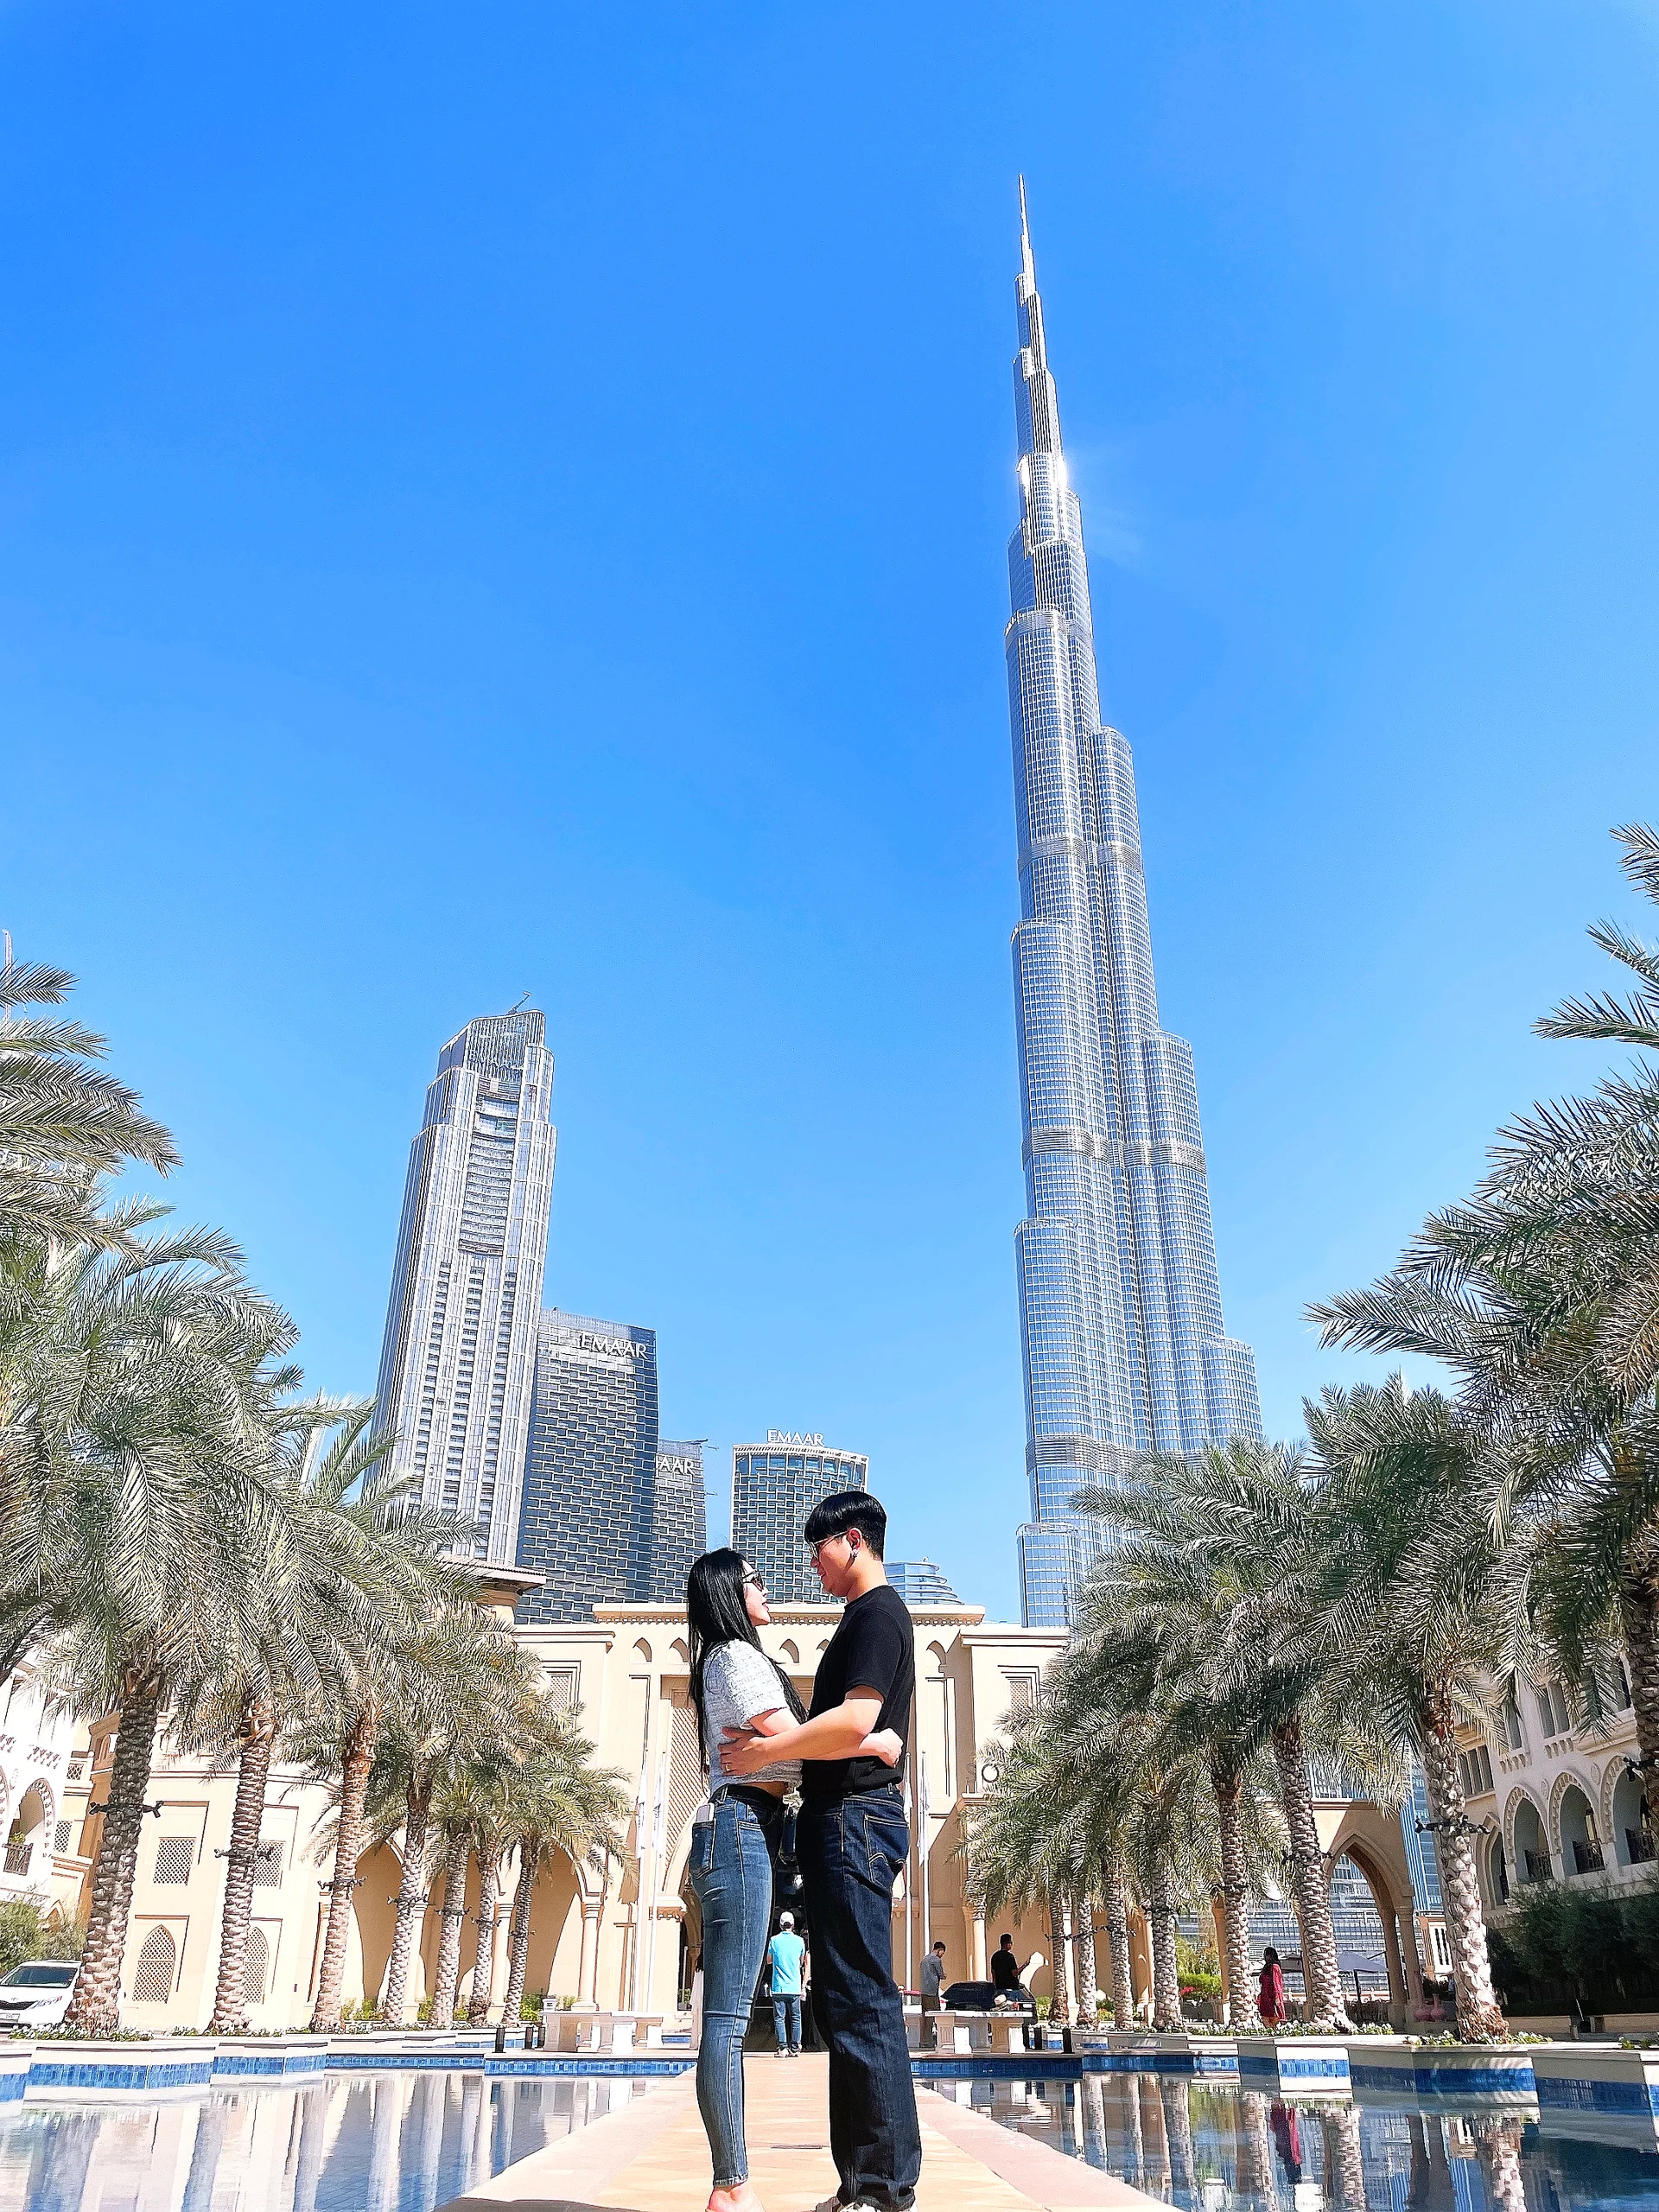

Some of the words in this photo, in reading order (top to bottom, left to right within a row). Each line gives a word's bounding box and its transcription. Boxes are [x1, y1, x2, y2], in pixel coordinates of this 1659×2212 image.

[579, 1332, 647, 1359] EMAAR
[766, 1428, 825, 1447] EMAAR
[657, 1455, 695, 1475] AAR
